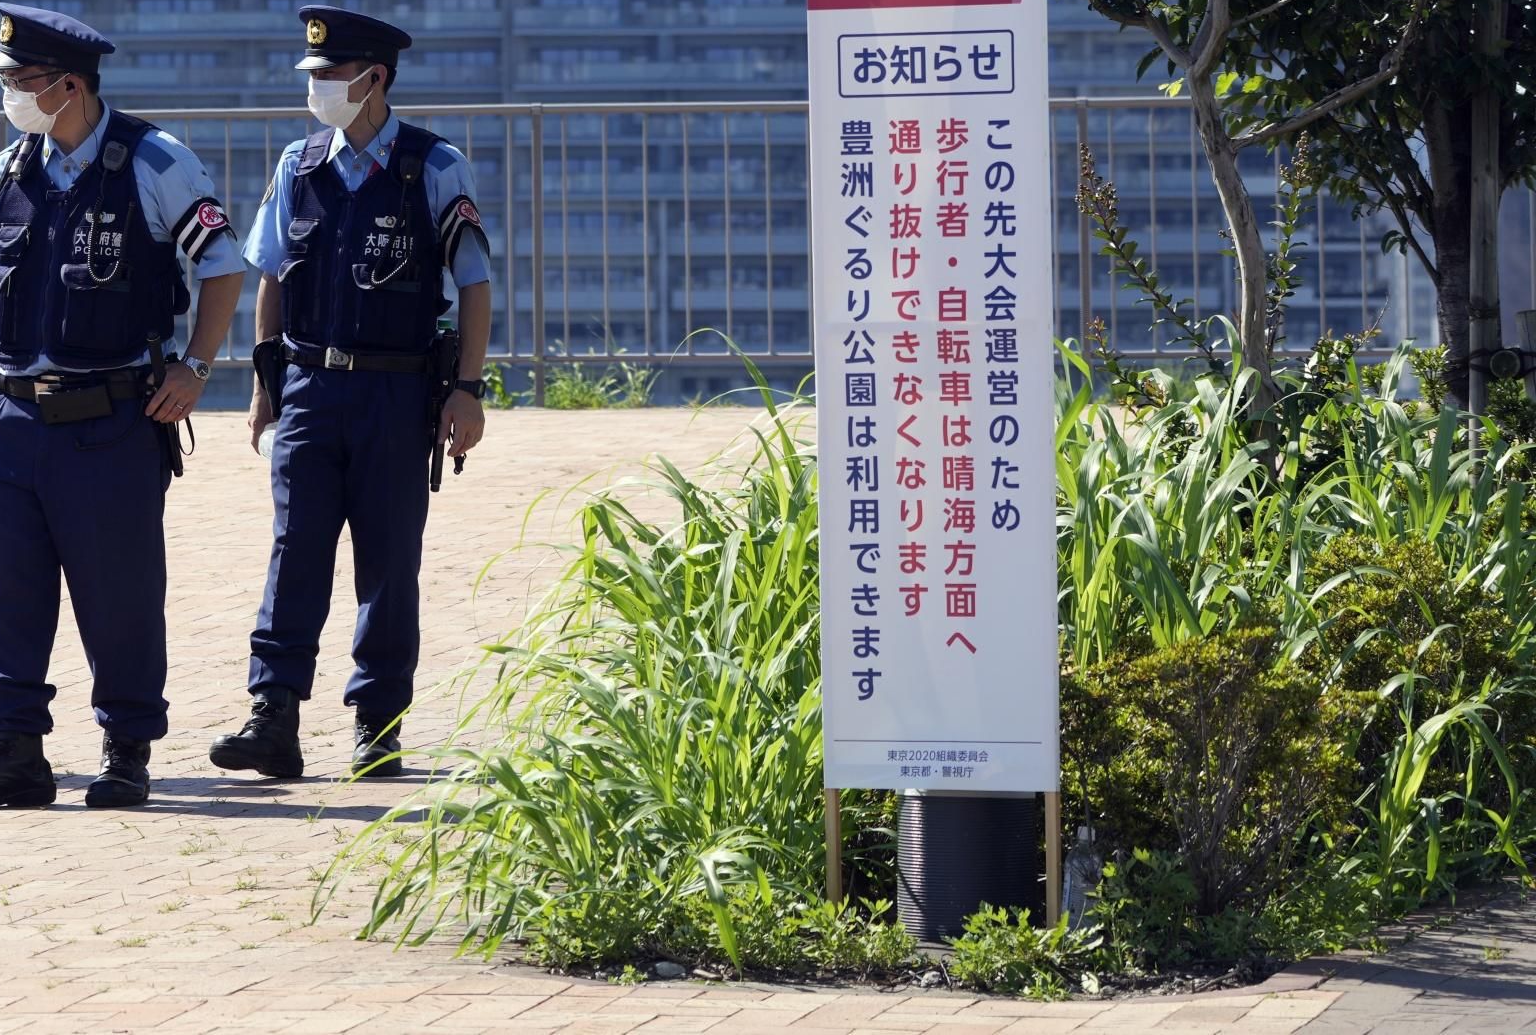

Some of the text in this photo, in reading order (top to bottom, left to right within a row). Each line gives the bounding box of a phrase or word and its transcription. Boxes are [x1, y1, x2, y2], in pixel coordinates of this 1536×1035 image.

[852, 43, 1002, 85] お知らせ
[74, 245, 121, 258] POICE
[983, 119, 1022, 533] この先大会運営のため
[840, 120, 882, 702] 豊洲ぐるり公園は利用できます
[888, 119, 929, 618] 通り抜けできなくなります
[935, 117, 977, 655] 歩行者・自転車は晴海方面へ
[887, 750, 989, 762] 東京2020組織委員会
[900, 766, 974, 778] 東京都・警視庁
